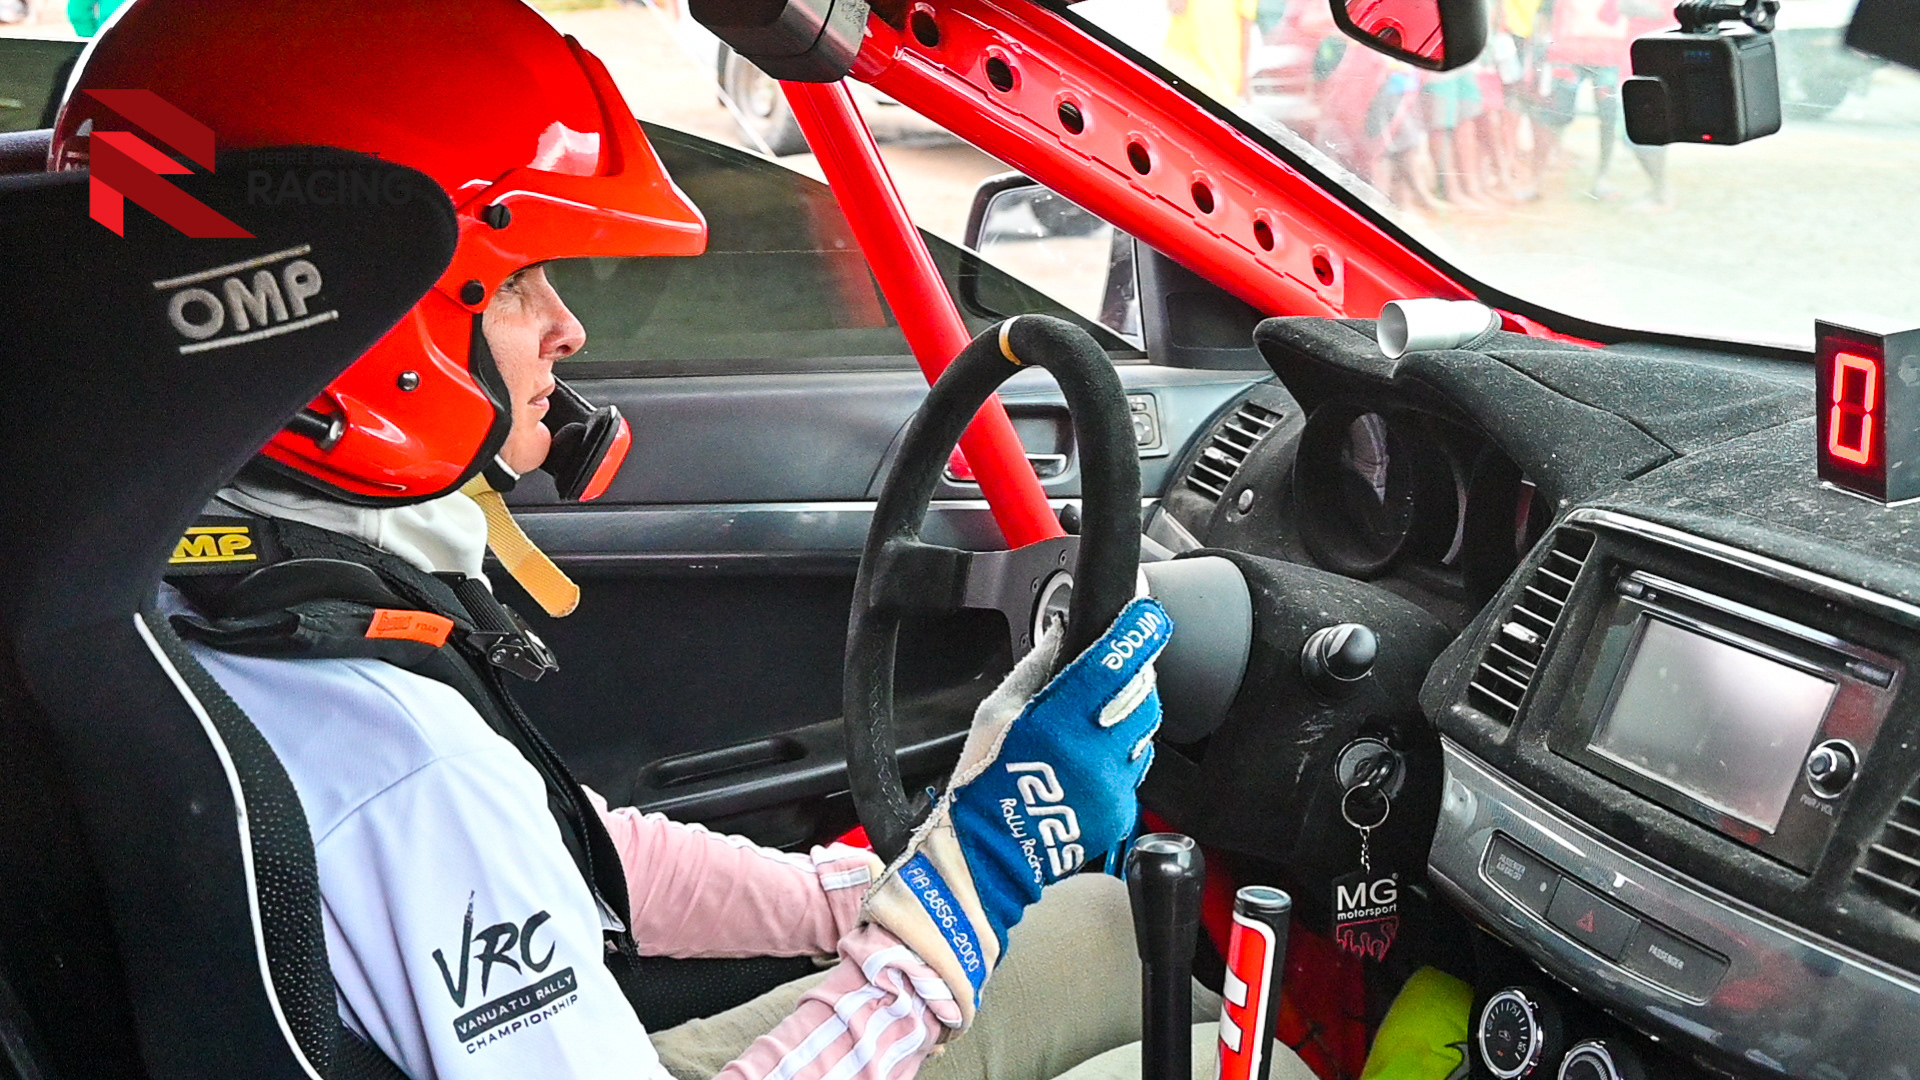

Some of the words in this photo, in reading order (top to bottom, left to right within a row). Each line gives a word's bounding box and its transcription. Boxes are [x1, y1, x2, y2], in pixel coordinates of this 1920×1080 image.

[168, 259, 322, 340] OMP
[173, 534, 252, 557] MP
[1102, 611, 1162, 670] virage
[999, 798, 1028, 838] Rally
[907, 867, 931, 893] FIA
[923, 886, 980, 974] 8856-2000
[1337, 878, 1397, 911] MG
[1337, 904, 1397, 921] motorsport
[432, 890, 556, 1008] VRC
[1649, 945, 1684, 970] PASSENGER
[458, 995, 530, 1034] VANUATU
[535, 974, 573, 1001] RALLY
[466, 994, 578, 1054] CHAMPIONSHIP
